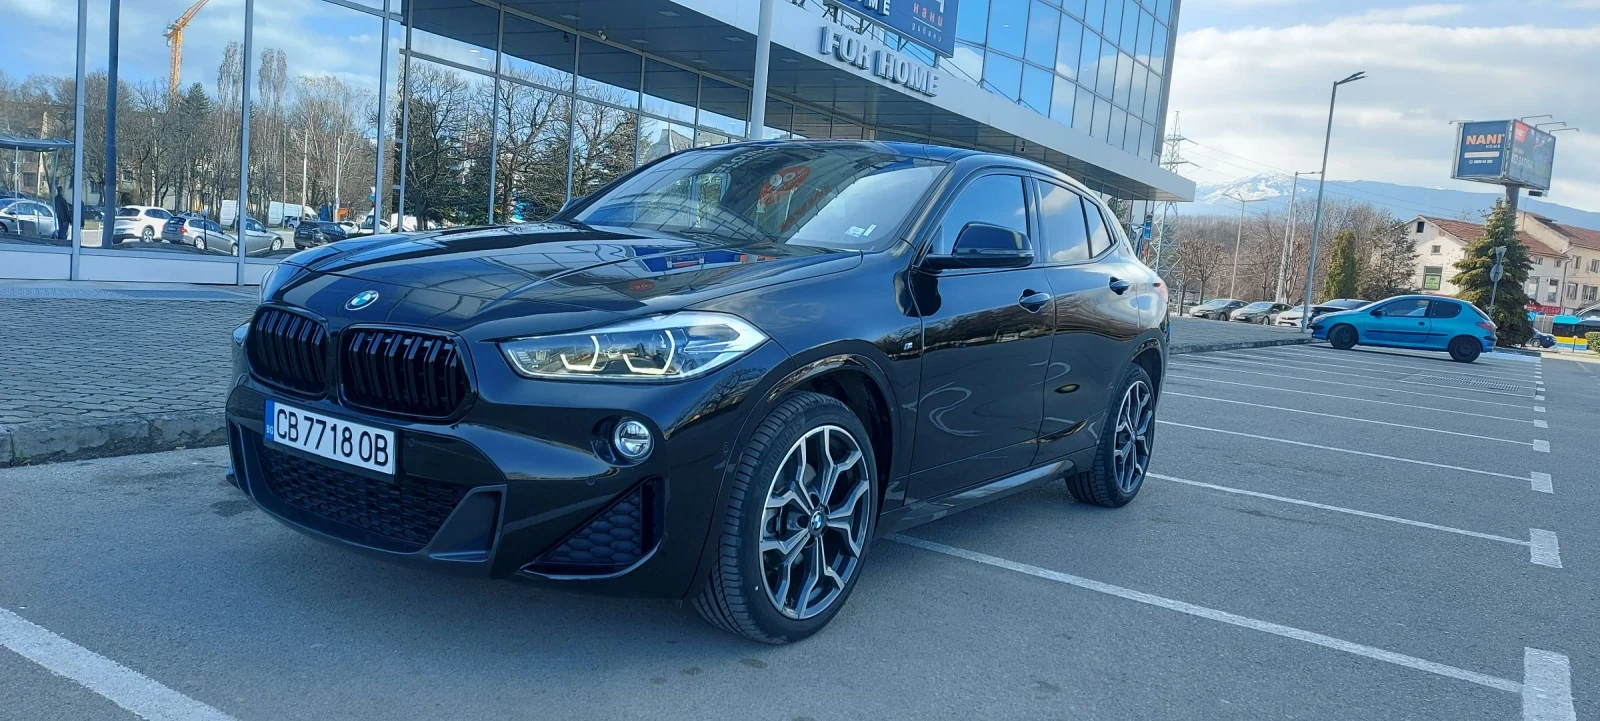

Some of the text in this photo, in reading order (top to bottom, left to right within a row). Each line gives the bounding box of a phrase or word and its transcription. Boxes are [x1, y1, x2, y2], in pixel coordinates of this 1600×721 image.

[821, 26, 938, 97] FOR HOME
[266, 424, 274, 435] BG
[277, 408, 389, 467] CB 7718 OB
